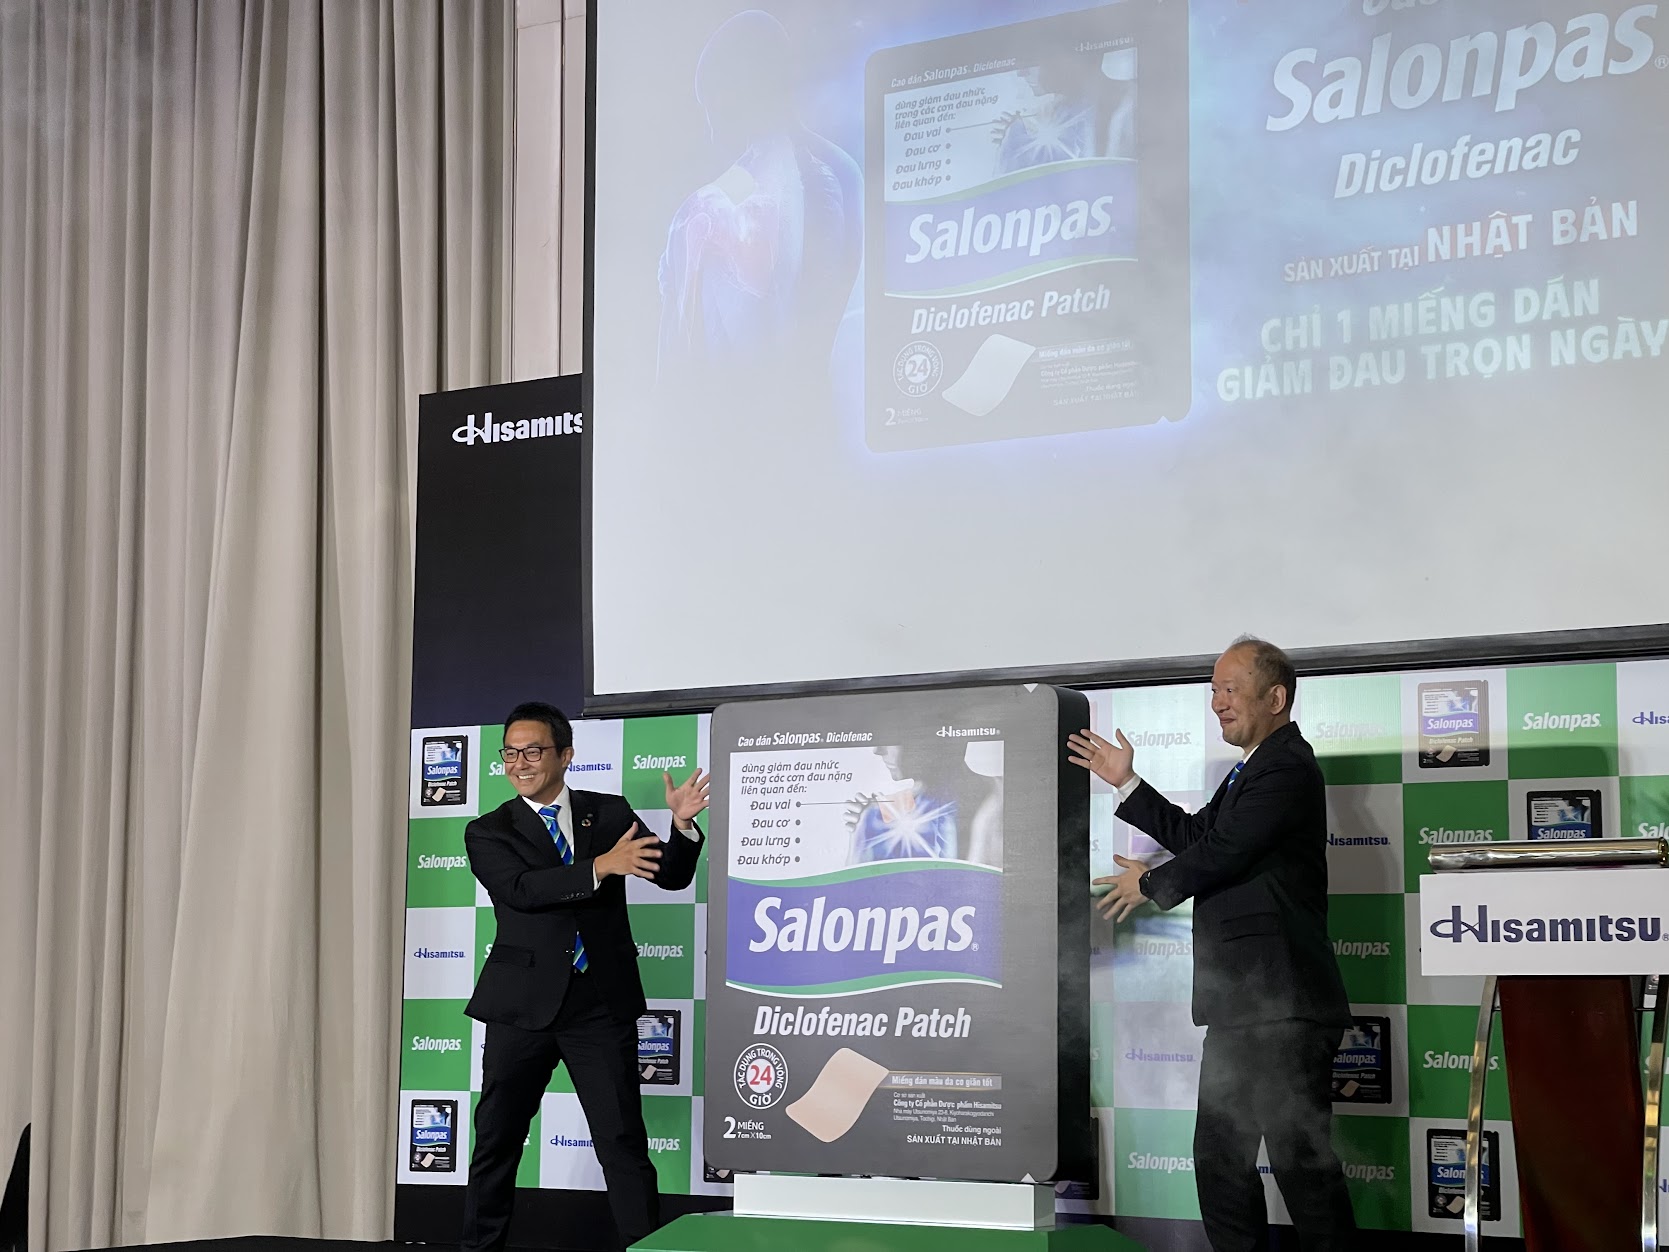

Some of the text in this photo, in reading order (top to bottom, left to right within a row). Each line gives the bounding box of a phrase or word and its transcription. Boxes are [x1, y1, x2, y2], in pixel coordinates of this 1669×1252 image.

[923, 65, 968, 82] Salonpas
[895, 109, 919, 120] trong
[920, 105, 935, 115] các
[913, 116, 935, 128] quan
[903, 126, 942, 142] Đau vai
[905, 146, 926, 157] Đau
[895, 164, 916, 174] Đau
[1334, 128, 1582, 199] Diclofenac
[892, 180, 913, 191] Đau
[905, 195, 1114, 264] Salonpas
[1330, 244, 1382, 277] XUẤT
[1388, 245, 1420, 271] TẠI
[1428, 210, 1533, 263] NHẬT
[1552, 196, 1638, 246] BẢN
[911, 284, 1111, 335] Diclofenac Patch
[1336, 309, 1352, 344] 1
[1368, 286, 1496, 342] MIẾNG
[1514, 274, 1600, 324] DÁN
[1216, 315, 1669, 402] GIẢM ĐAU TRỌN NGÀY
[907, 359, 929, 378] 24
[885, 407, 897, 426] 2
[452, 411, 583, 446] Hisamits
[1427, 718, 1474, 731] Salonpas
[1522, 711, 1601, 732] Salonpas
[737, 731, 873, 747] Cao dán Salonpas Diclofenac
[935, 725, 997, 738] Hisamitsu
[1127, 730, 1192, 749] Salonpas
[427, 765, 459, 776] Salonpas
[632, 754, 686, 771] Salonpas
[741, 759, 840, 774] dùng giảm đau nhức
[741, 771, 853, 785] trong các cơn đau nặng
[741, 783, 807, 796] liên quan đến:
[750, 799, 791, 811] Đau vai
[751, 818, 791, 829] Đau cơ
[741, 835, 791, 848] Đau lưng
[417, 854, 467, 870] Salonpas
[737, 854, 791, 867] Đau khớp
[748, 896, 976, 964] Salonpas
[1429, 904, 1662, 943] Hisamitsu
[413, 947, 465, 960] Hisamitsu
[636, 942, 684, 961] alonpas
[1136, 939, 1192, 959] alonpas
[1333, 938, 1391, 960] lonpas
[752, 1005, 972, 1038] Diclofenac Patch
[411, 1036, 462, 1054] Salonpas
[1124, 1047, 1194, 1062] Hisamitsu
[1333, 1052, 1377, 1066] alonpas
[1423, 1050, 1499, 1073] Salons
[749, 1064, 772, 1086] 24
[756, 1048, 780, 1066] TRONG
[775, 1063, 785, 1089] VÒNG
[891, 1075, 913, 1086] Miếng
[944, 1077, 954, 1086] da
[955, 1078, 964, 1087] co
[749, 1092, 772, 1106] GIỜ
[908, 1100, 915, 1108] ty
[416, 1129, 448, 1141] Salonpas
[723, 1116, 765, 1139] 2 MIẾNG
[942, 1124, 1002, 1136] Thuốc dùng ngoài
[550, 1134, 593, 1148] Hisamit
[648, 1137, 681, 1153] npas
[906, 1133, 1002, 1147] SẢN XUẤT TẠI NHẬT BẢN
[1127, 1151, 1194, 1174] Salonpas
[1341, 1160, 1395, 1183] lonpas
[1437, 1166, 1485, 1179] Salons
